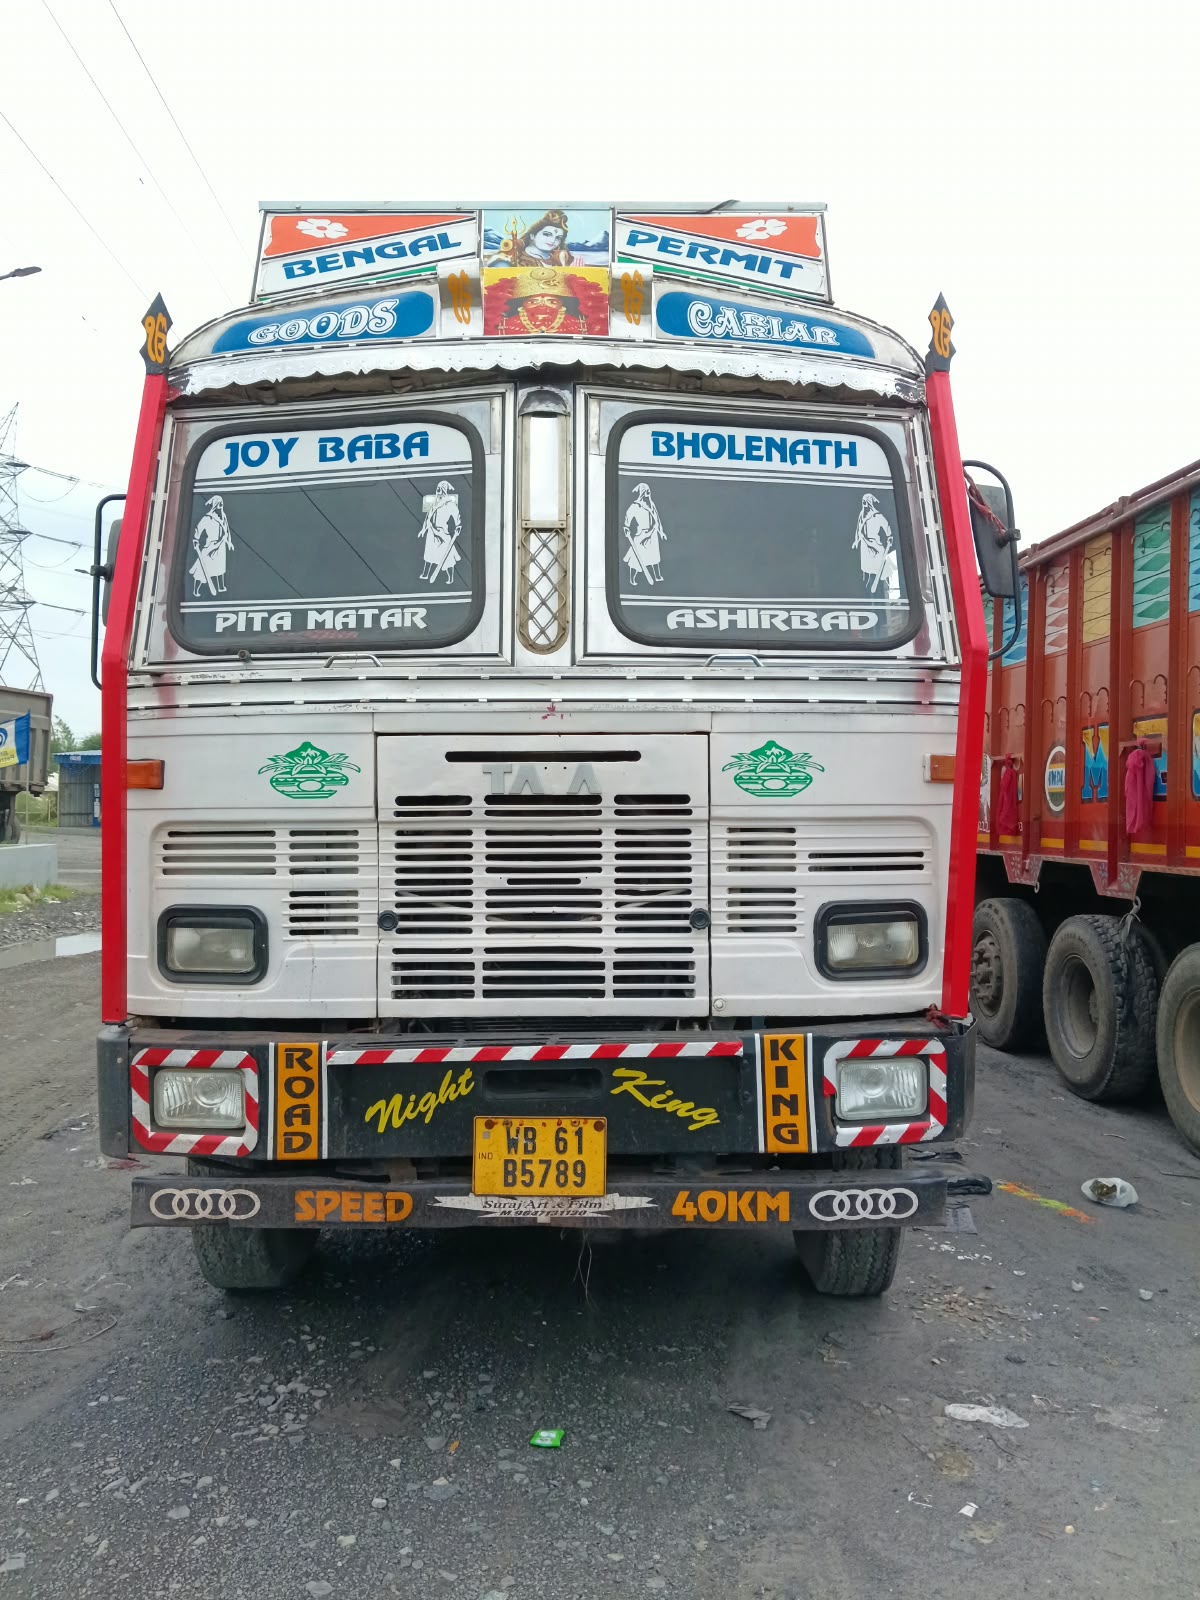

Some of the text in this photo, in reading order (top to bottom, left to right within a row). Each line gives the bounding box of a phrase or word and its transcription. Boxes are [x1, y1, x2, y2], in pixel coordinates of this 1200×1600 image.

[282, 232, 462, 279] BENGAL
[626, 229, 804, 279] PERMIT
[248, 299, 399, 344] GOODS
[223, 431, 429, 475] JOY BABA
[651, 431, 857, 469] BHOLENATH
[215, 607, 428, 632] PITA MATAR
[666, 608, 879, 631] ASHIRBAD
[283, 1047, 315, 1154] ROAD
[364, 1067, 475, 1133] Night
[610, 1067, 720, 1131] King
[769, 1039, 800, 1145] KING
[478, 1152, 493, 1160] IND
[506, 1126, 583, 1155] WB 61
[503, 1159, 586, 1188] B5789
[295, 1190, 413, 1222] SPEED
[482, 1200, 523, 1210] Suraj
[524, 1200, 549, 1209] Art
[567, 1200, 602, 1211] Film
[671, 1190, 790, 1222] 40KM
